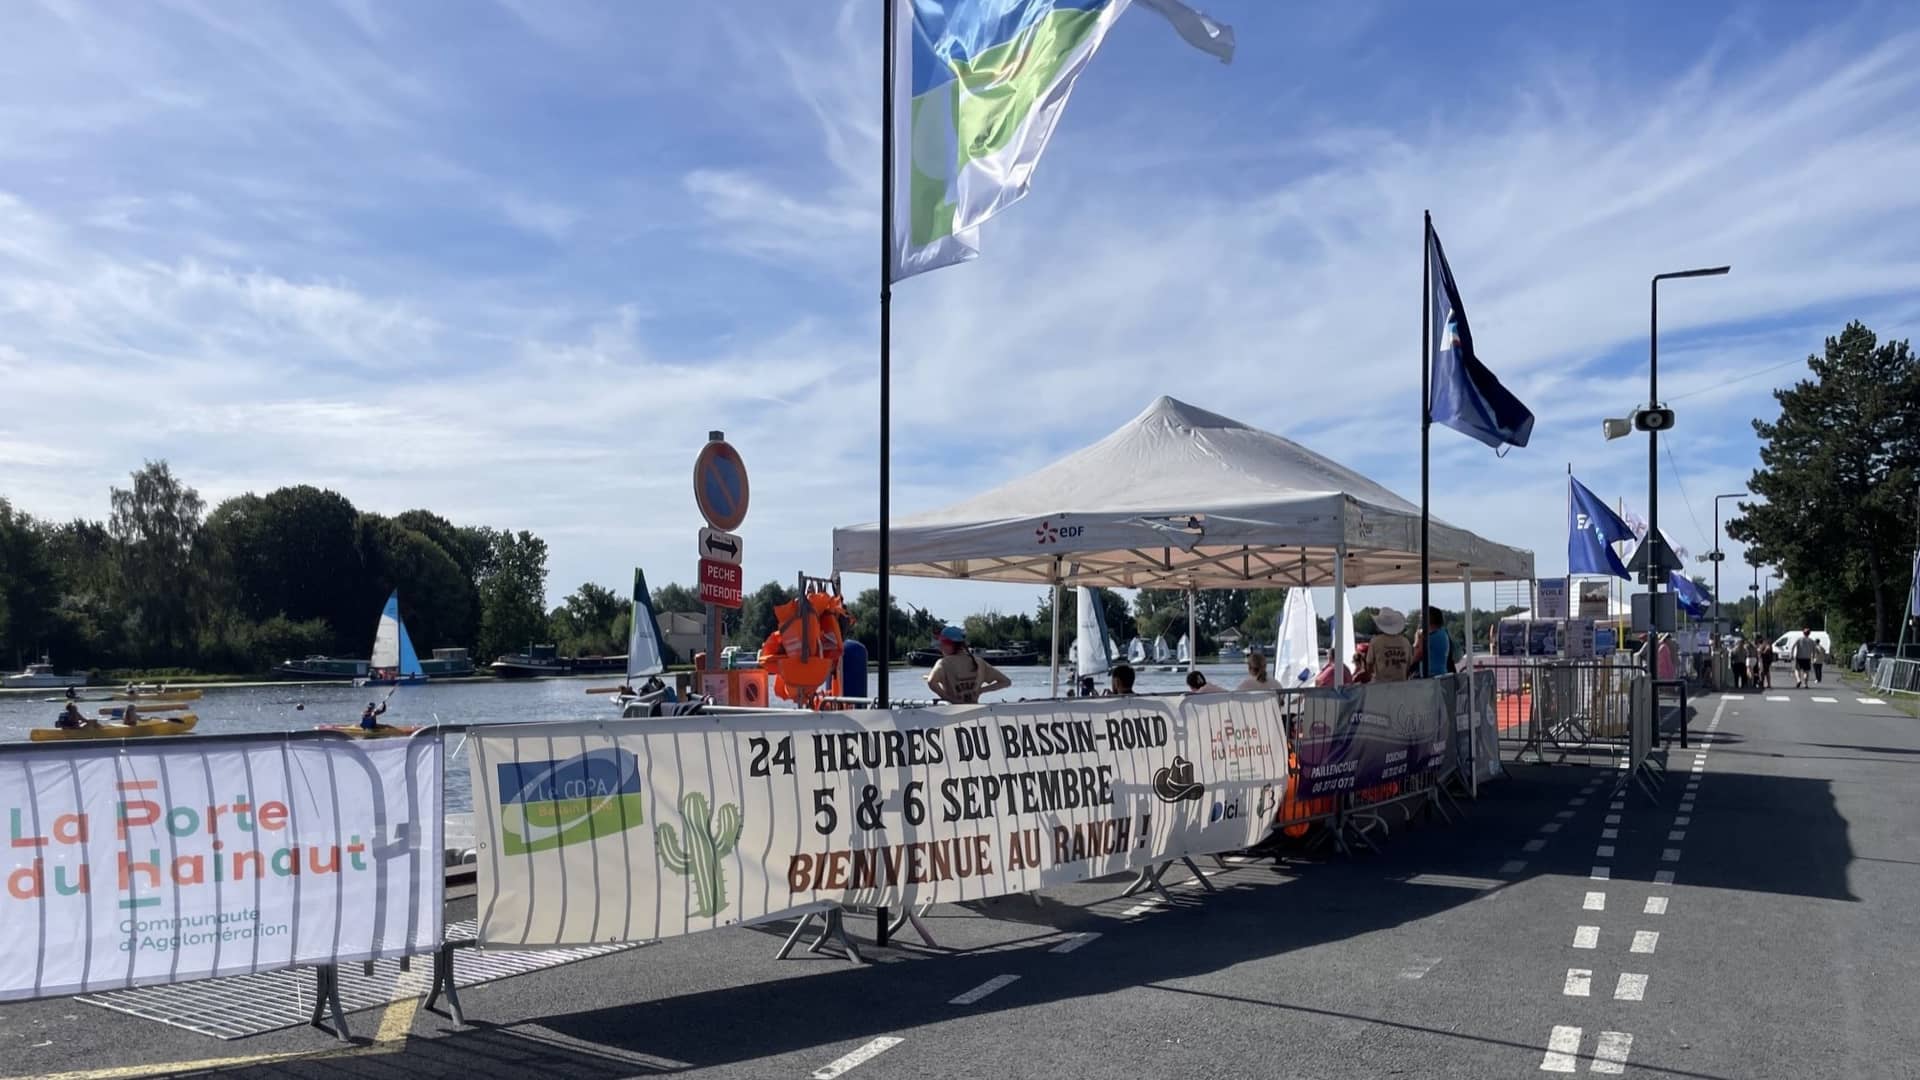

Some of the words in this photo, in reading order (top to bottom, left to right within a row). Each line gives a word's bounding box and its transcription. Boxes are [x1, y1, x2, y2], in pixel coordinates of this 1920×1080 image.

[700, 583, 743, 602] INTERDITE
[707, 565, 736, 582] PECHE
[748, 735, 796, 778] 24
[811, 727, 944, 774] HEURES
[954, 725, 992, 763] DU
[999, 714, 1168, 760] BASSIN-ROND
[1224, 724, 1258, 742] Porte
[1228, 740, 1272, 759] Hainau
[10, 807, 90, 849] La
[115, 793, 289, 842] Porte
[812, 786, 838, 836] 5
[856, 783, 887, 832] &
[903, 780, 926, 827] 6
[940, 764, 1115, 824] SEPTEMBRE
[7, 856, 90, 901] du
[117, 834, 367, 892] Hainaut
[787, 833, 995, 894] BIENVENUE
[1007, 827, 1041, 874] AU
[1053, 815, 1132, 866] RANCH
